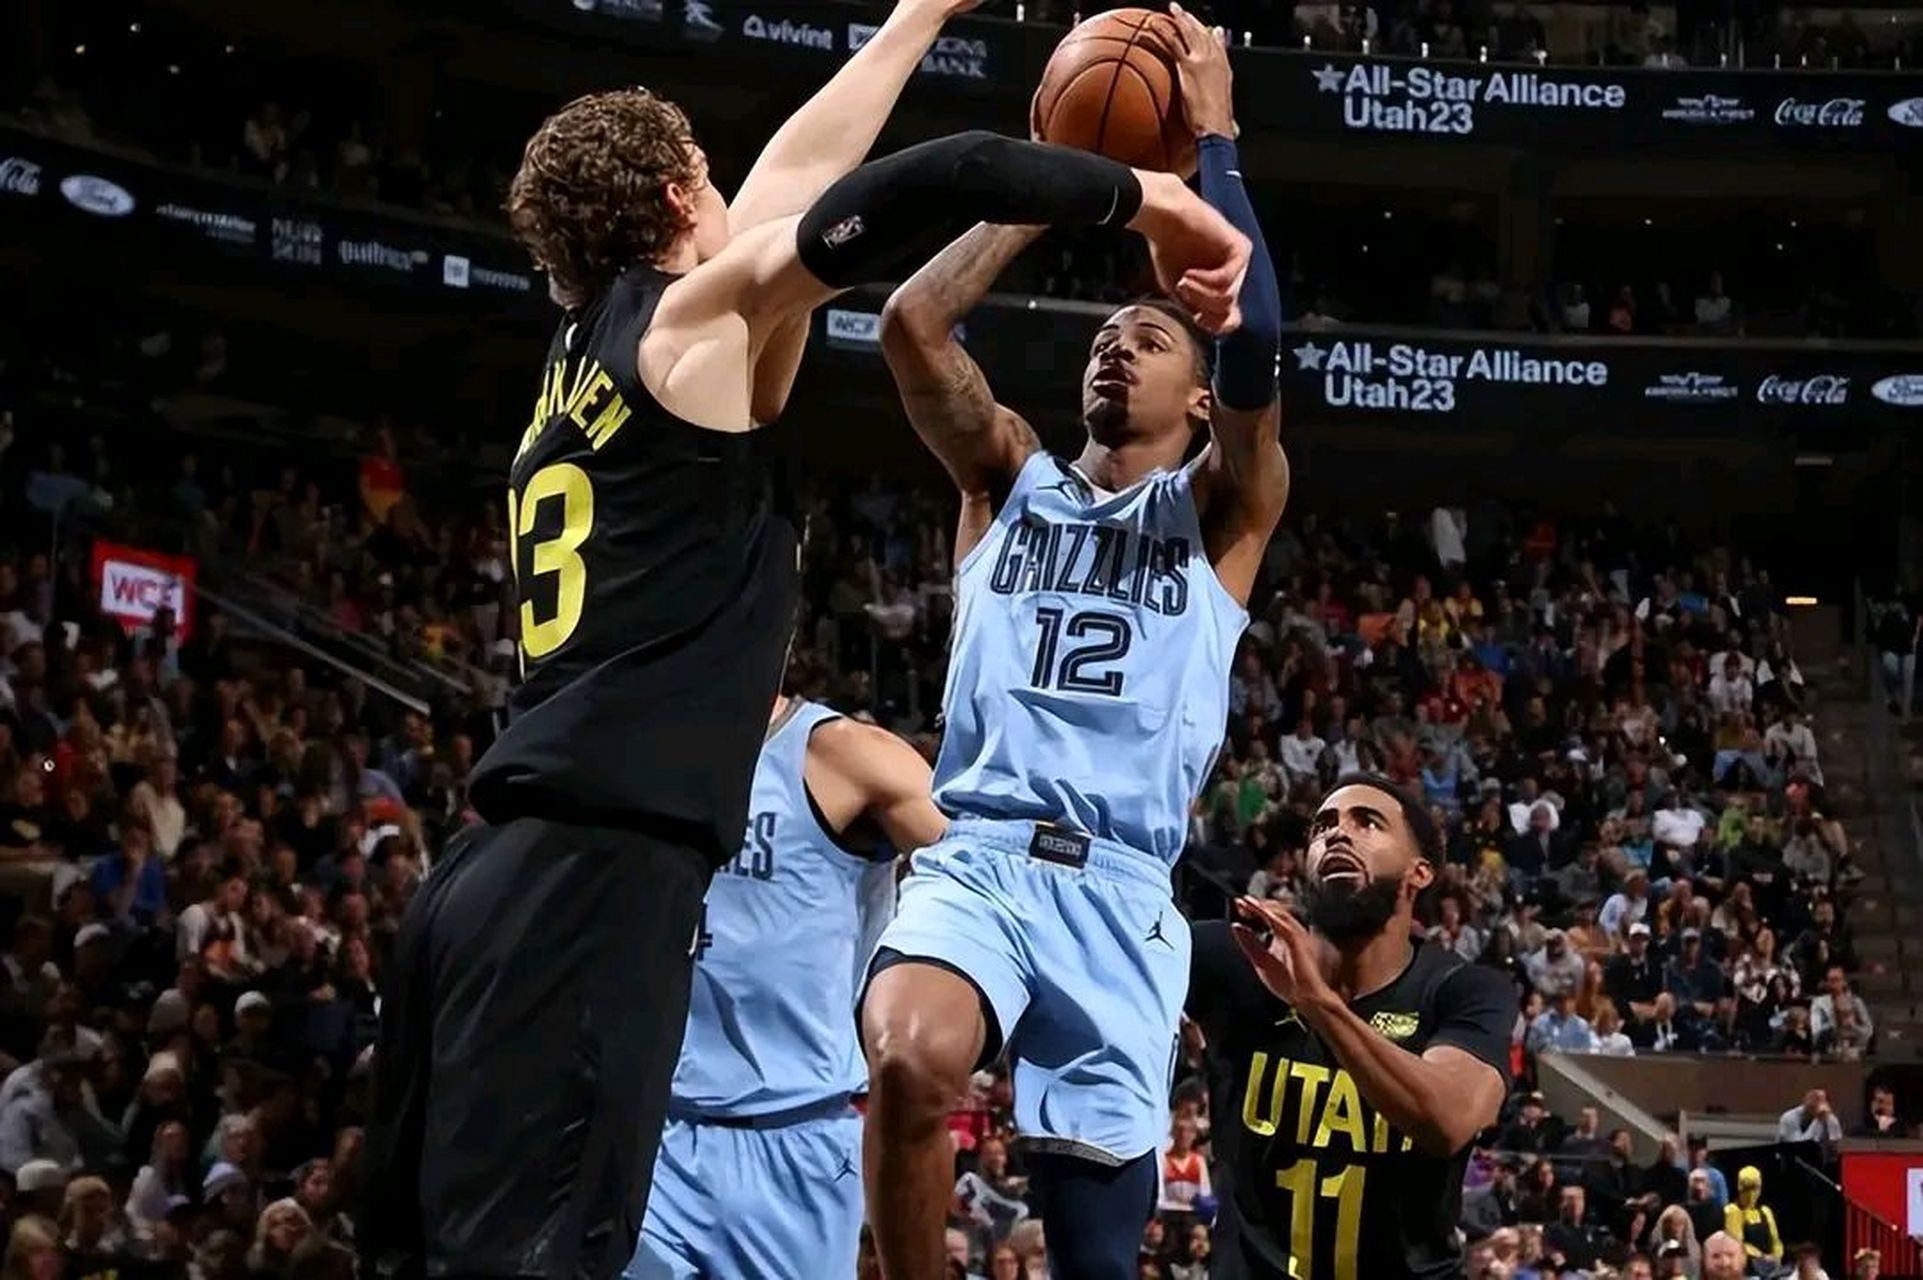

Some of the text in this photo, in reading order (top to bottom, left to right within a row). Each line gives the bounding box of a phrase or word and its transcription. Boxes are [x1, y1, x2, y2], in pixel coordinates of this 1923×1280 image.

[1344, 96, 1474, 134] Utah23
[1345, 64, 1626, 108] All-Star Alliance
[1325, 341, 1609, 386] All-Star Alliance
[1325, 373, 1456, 412] Utah23
[508, 462, 594, 658] 3
[989, 517, 1190, 617] GRIZZLIES
[1030, 606, 1133, 697] 12
[1242, 1051, 1413, 1154] UTA
[1275, 1158, 1367, 1280] 11
